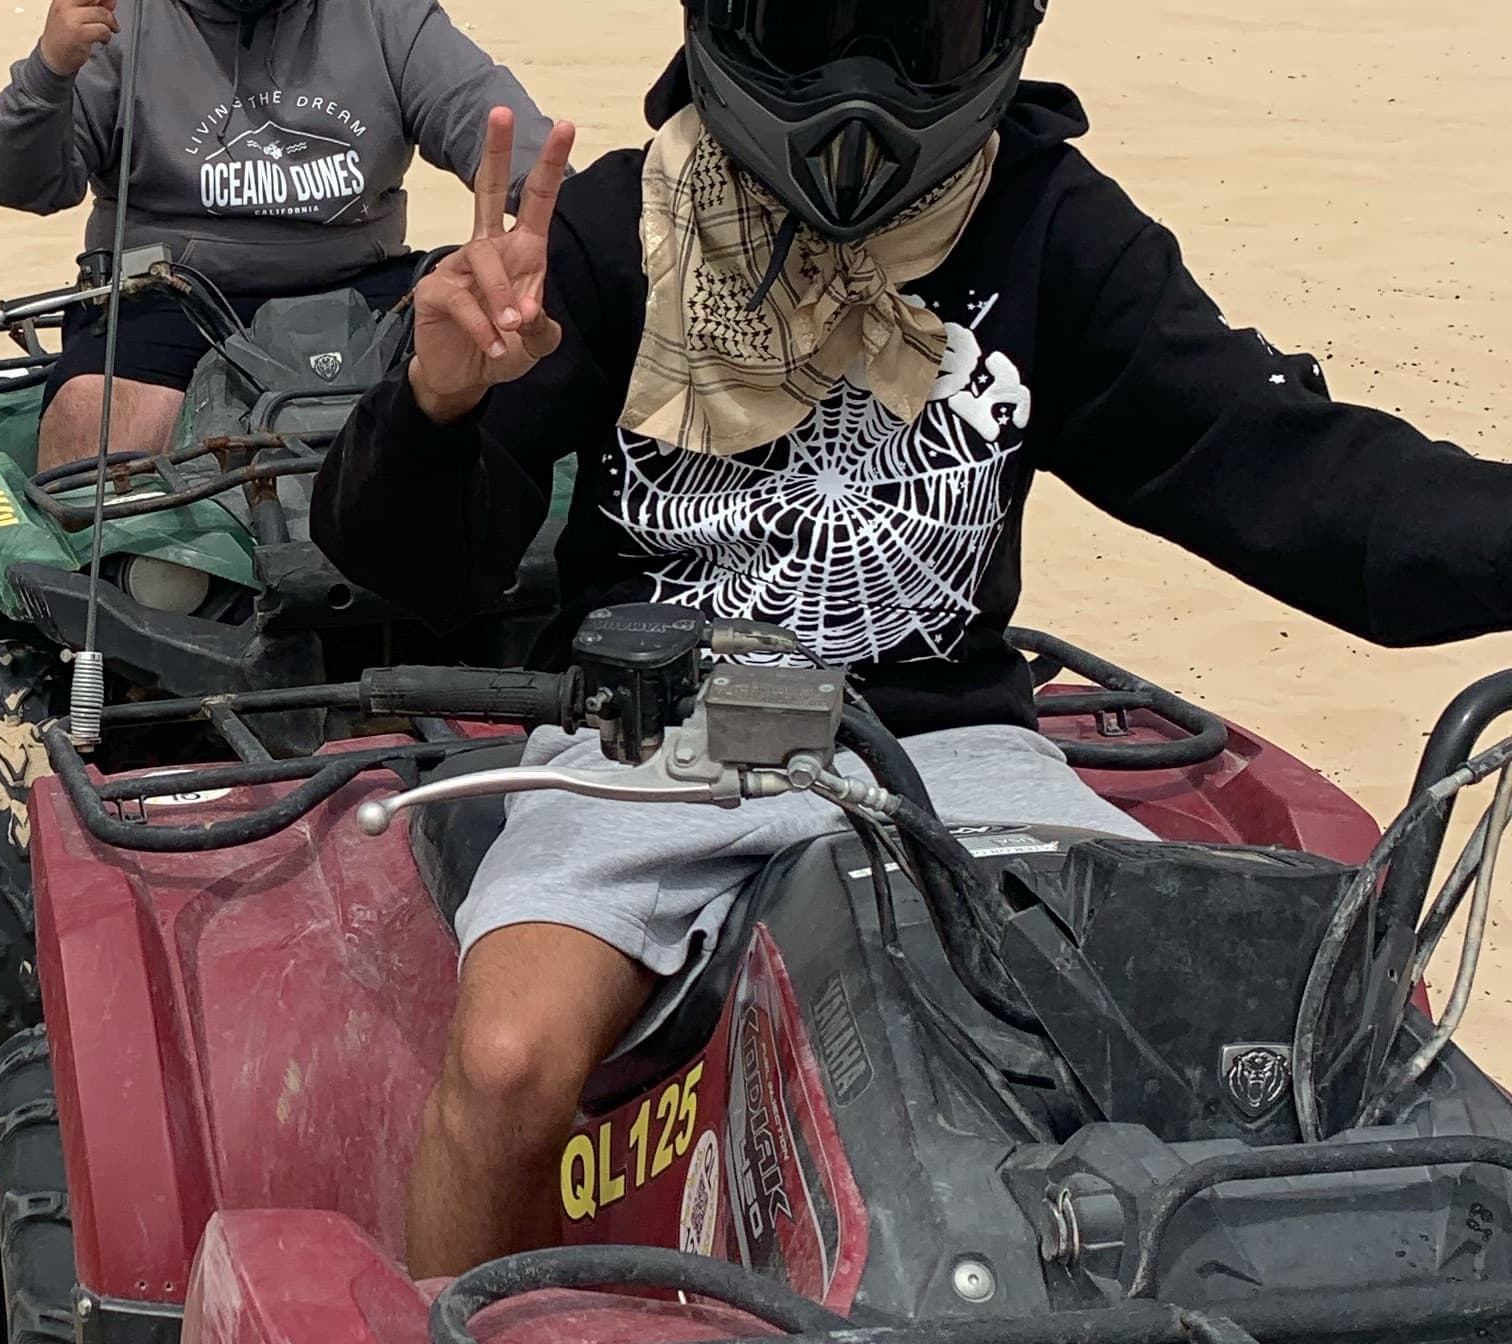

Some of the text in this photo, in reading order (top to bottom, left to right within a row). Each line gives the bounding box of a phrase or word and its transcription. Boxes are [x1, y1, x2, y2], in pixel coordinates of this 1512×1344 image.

[185, 90, 367, 155] LIVING THE DREAM
[200, 150, 365, 208] OCEANO DUNES
[254, 205, 320, 216] CALIFORNIA
[812, 975, 867, 1095] YAMAHA
[560, 1059, 705, 1221] QL 125
[739, 1002, 793, 1229] KODIAK
[767, 1083, 790, 1162] INJECTION
[738, 1139, 764, 1240] 450
